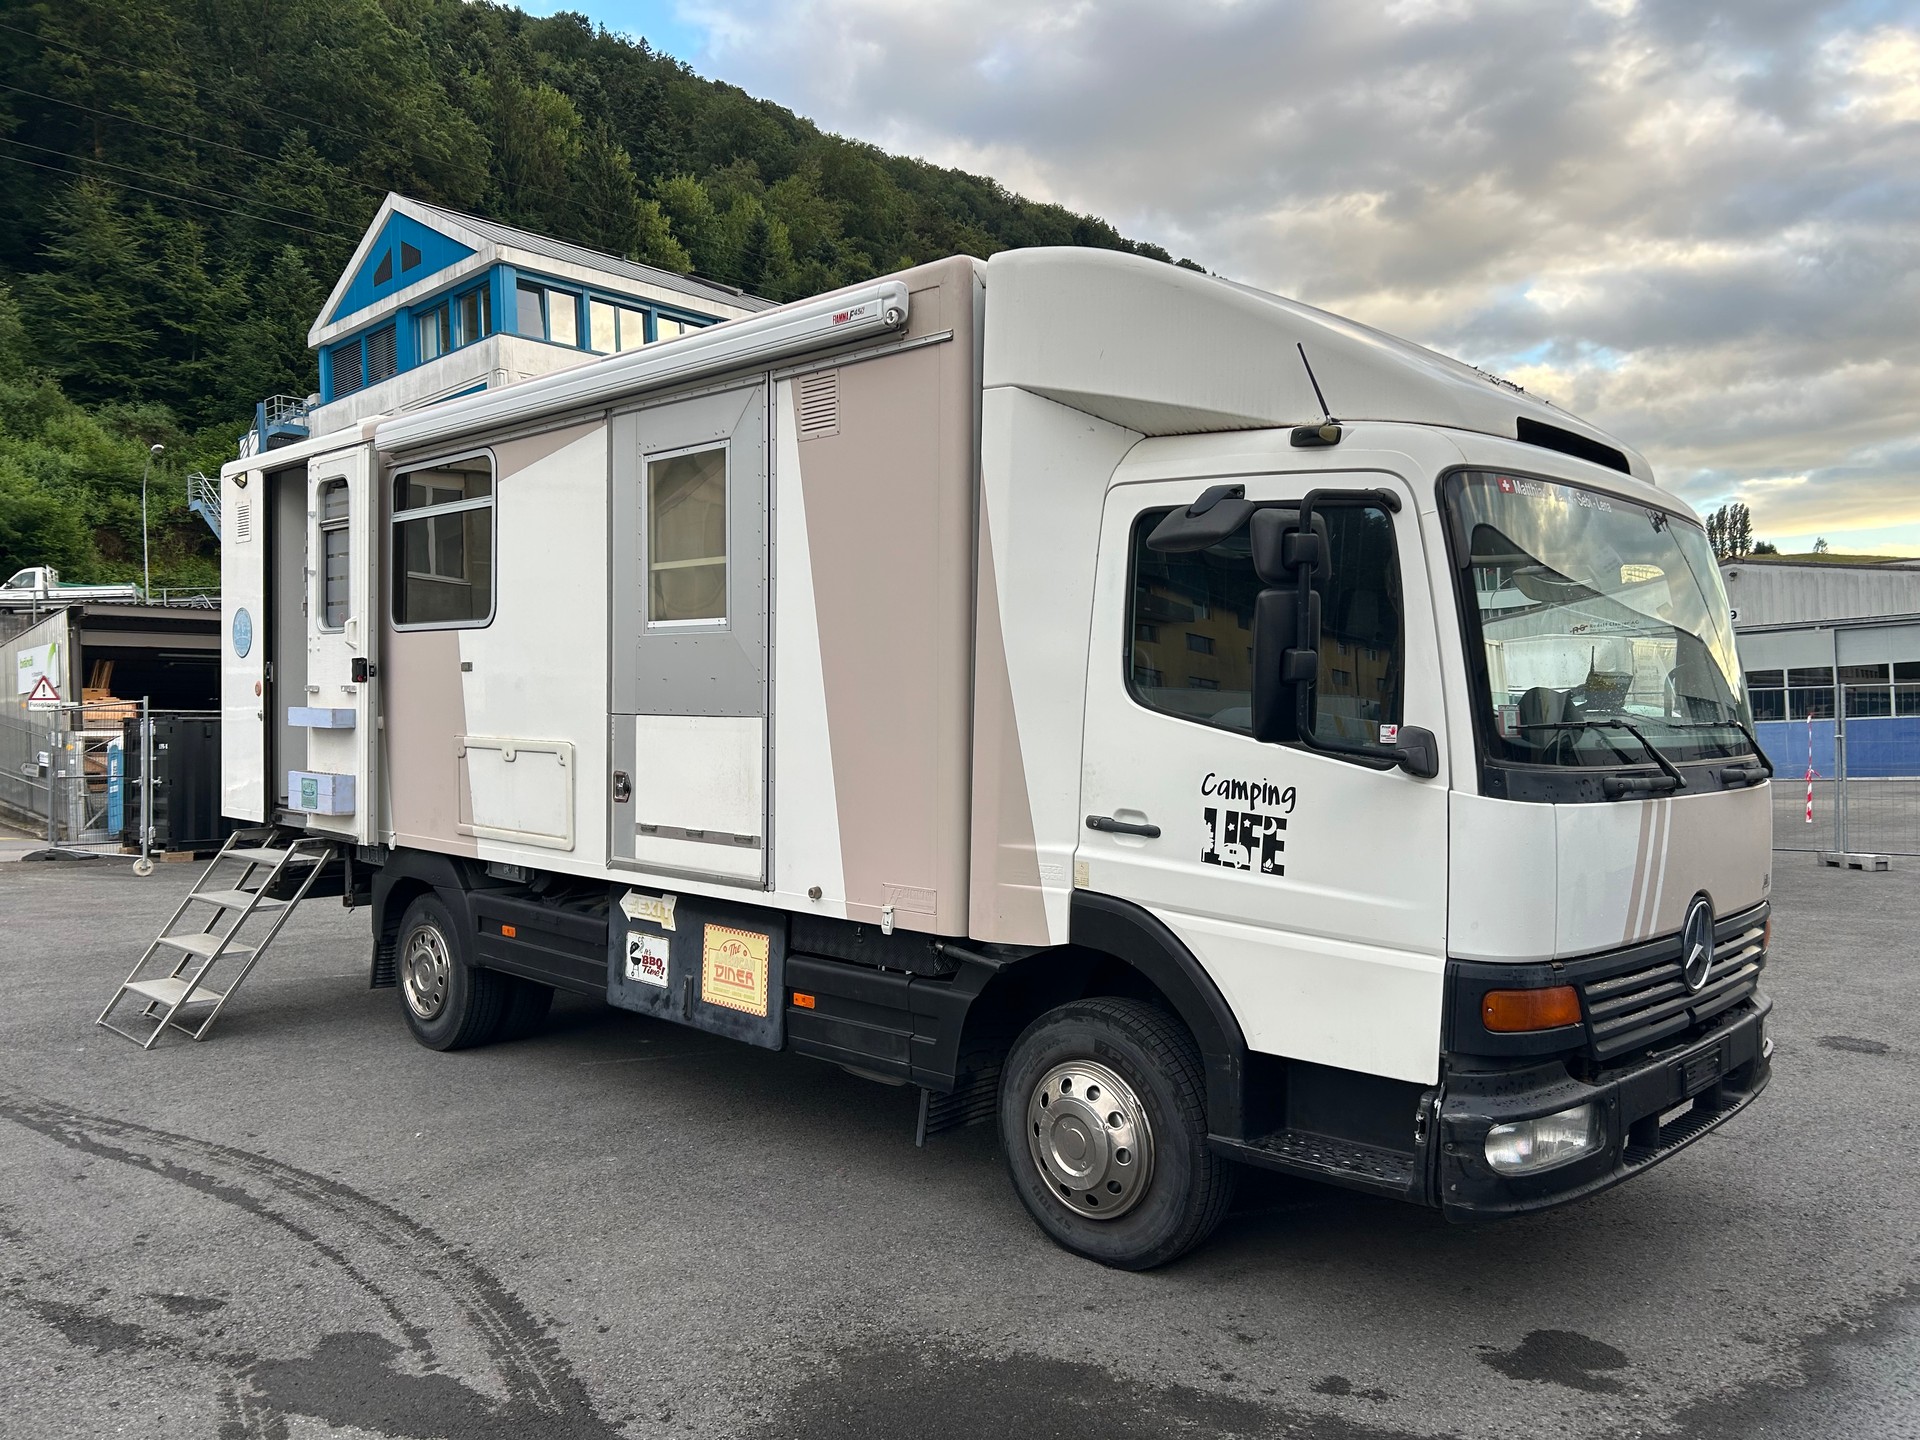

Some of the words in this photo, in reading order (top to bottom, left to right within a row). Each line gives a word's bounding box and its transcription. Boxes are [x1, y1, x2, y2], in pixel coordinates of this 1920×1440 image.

[1512, 479, 1545, 497] Matthia
[1201, 772, 1297, 814] Camping
[1200, 807, 1287, 876] LIFE
[638, 898, 671, 920] EXIT
[729, 943, 741, 956] The
[641, 955, 663, 970] BBQ
[642, 965, 666, 980] Time!
[714, 963, 755, 987] DINER
